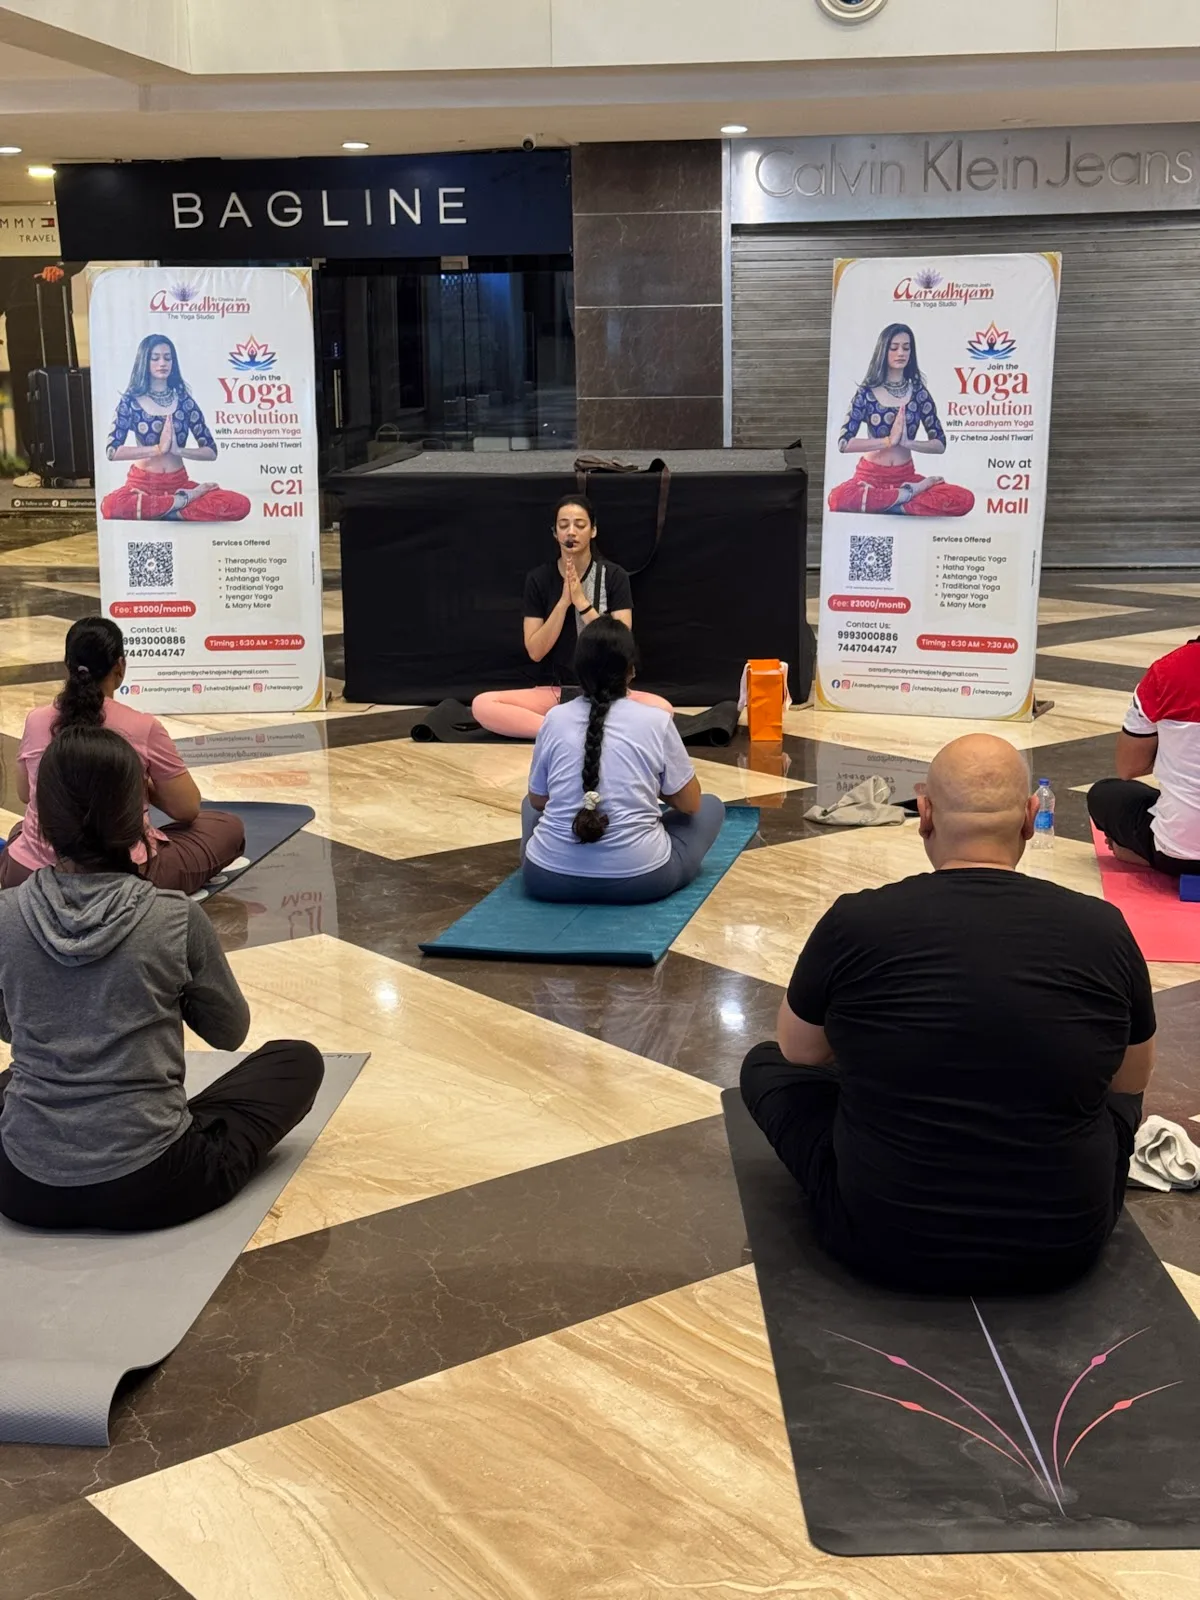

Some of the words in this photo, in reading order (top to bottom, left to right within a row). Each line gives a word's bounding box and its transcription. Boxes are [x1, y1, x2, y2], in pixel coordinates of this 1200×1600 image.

[754, 143, 905, 198] Calvin
[922, 138, 1038, 192] Klein
[1045, 136, 1194, 190] Jeans
[172, 186, 468, 229] BAGLINE
[20, 234, 56, 242] TRAVEL
[894, 278, 994, 306] Aaradhyam
[150, 290, 250, 318] Aaradhyam
[954, 367, 1029, 401] Yoga
[217, 378, 294, 410] Yoga
[947, 400, 1032, 416] Revolution
[215, 410, 299, 424] Revolution
[964, 420, 1012, 428] Aaradhyam
[1014, 420, 1034, 428] Yoga
[234, 428, 280, 436] Aaradhyam
[281, 428, 301, 436] Yoga
[988, 458, 1015, 468] Now
[1018, 458, 1032, 468] at
[260, 464, 287, 474] Now
[290, 464, 303, 474] at
[997, 474, 1030, 490] C21
[271, 480, 302, 495] C21
[263, 502, 303, 517] Mall
[986, 498, 1028, 514] Mall
[943, 554, 986, 563] Therapeutic
[988, 555, 1007, 564] Yoga
[966, 564, 985, 573] Yoga
[942, 573, 977, 582] Ashtanga
[979, 574, 997, 582] Yoga
[981, 584, 1000, 592] Yoga
[941, 592, 968, 600] Iyengar
[970, 593, 989, 601] Yoga
[123, 636, 186, 645] 9993000886
[838, 631, 898, 641] 9993000886
[210, 640, 235, 648] Timing
[838, 643, 897, 654] 7447044747
[922, 639, 946, 648] Timing
[124, 649, 185, 657] 7447044747
